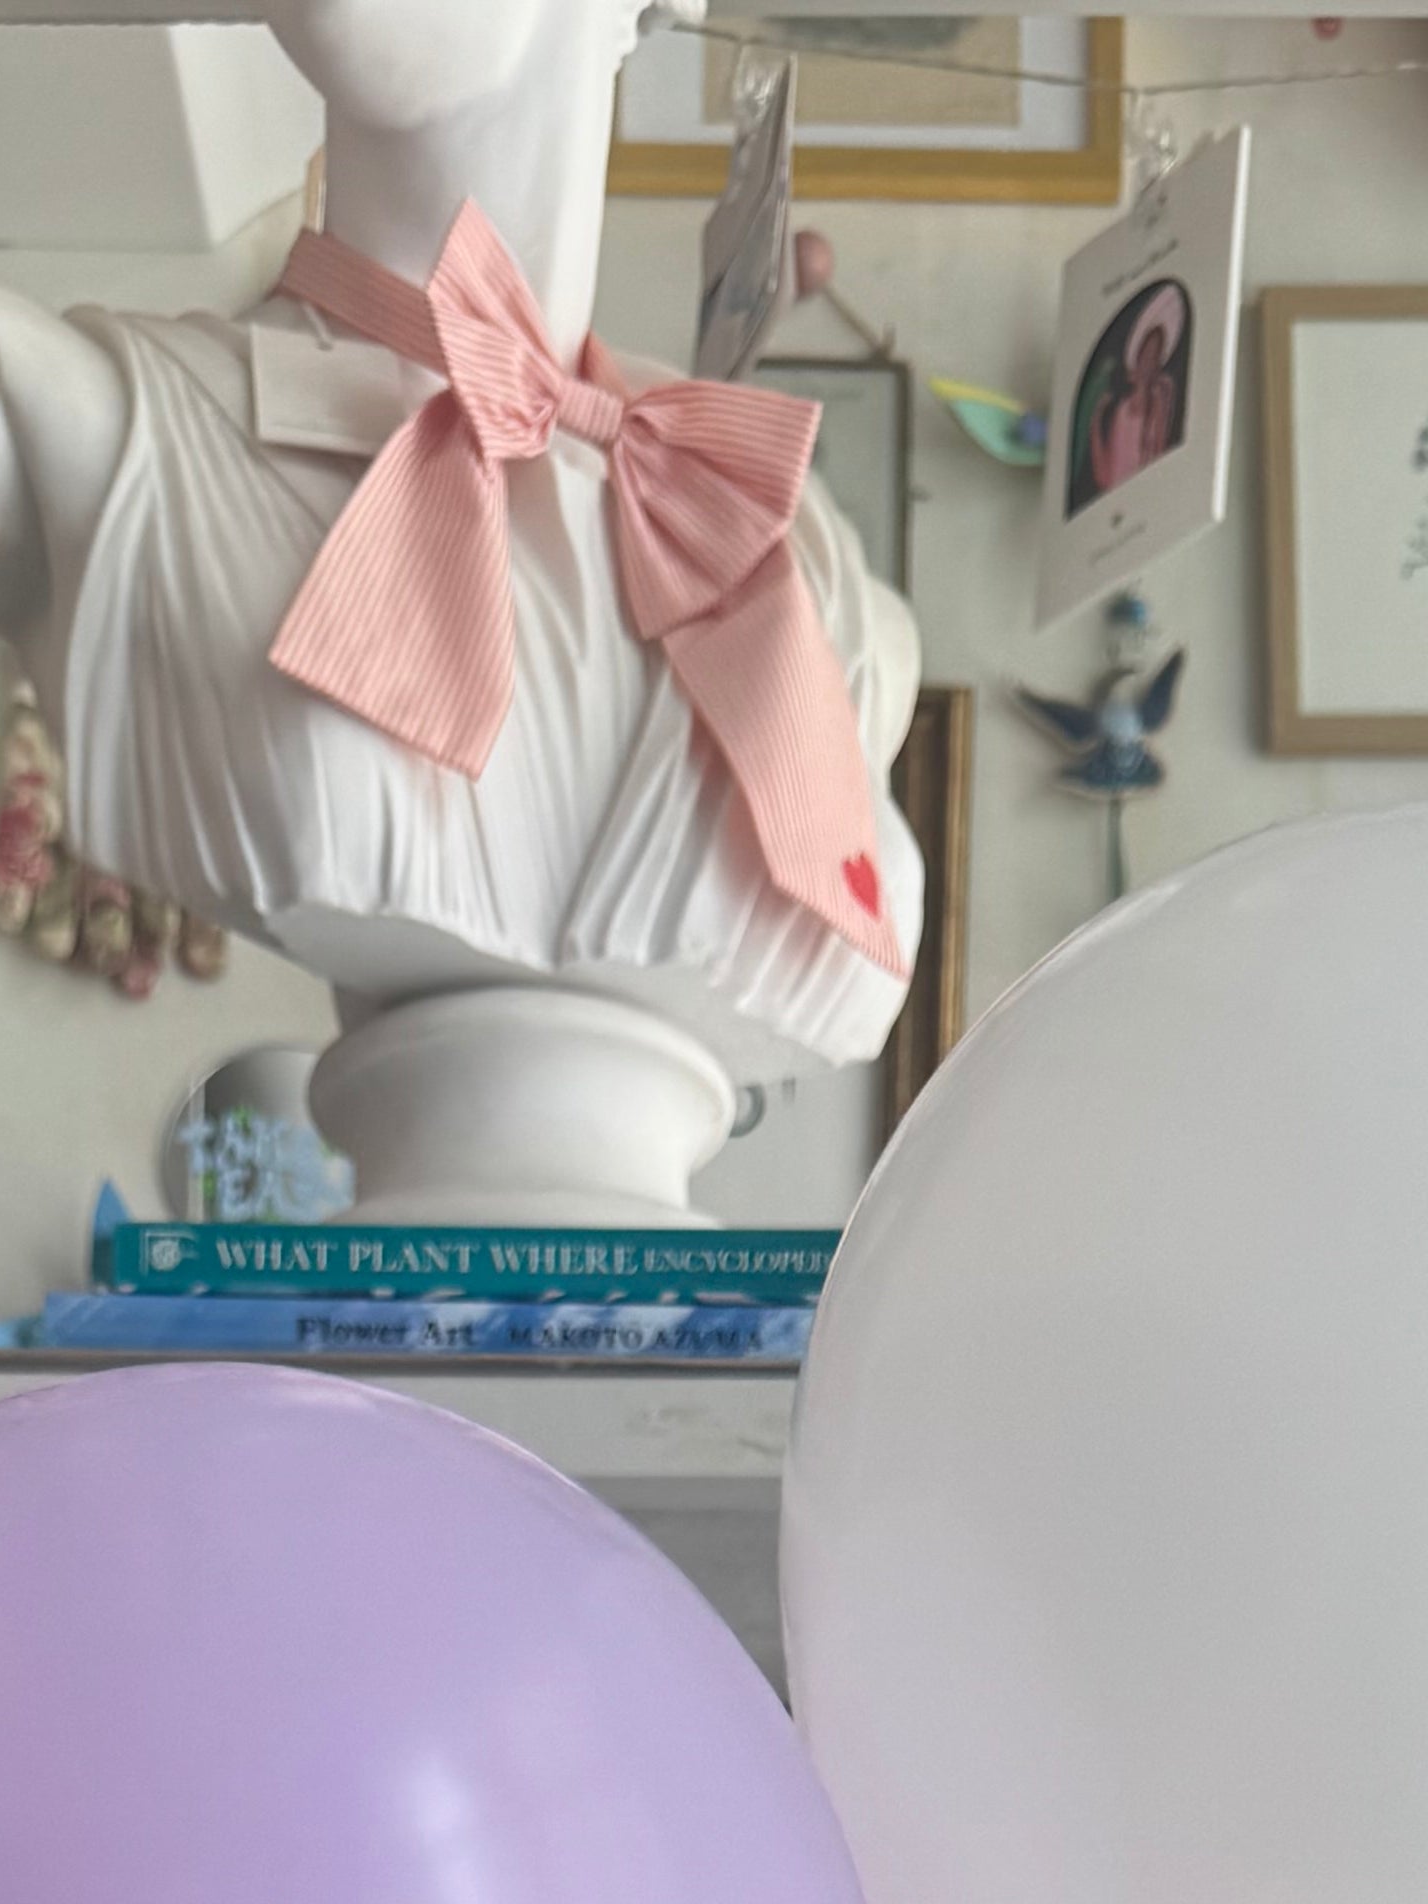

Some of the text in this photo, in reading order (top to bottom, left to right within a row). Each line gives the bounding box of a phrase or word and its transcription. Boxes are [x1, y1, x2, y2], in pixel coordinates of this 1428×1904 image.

[216, 1238, 338, 1272] WHAT
[348, 1239, 481, 1274] PLANT
[490, 1241, 638, 1276] WHERE
[296, 1315, 409, 1345] Flower
[424, 1317, 476, 1347] Art
